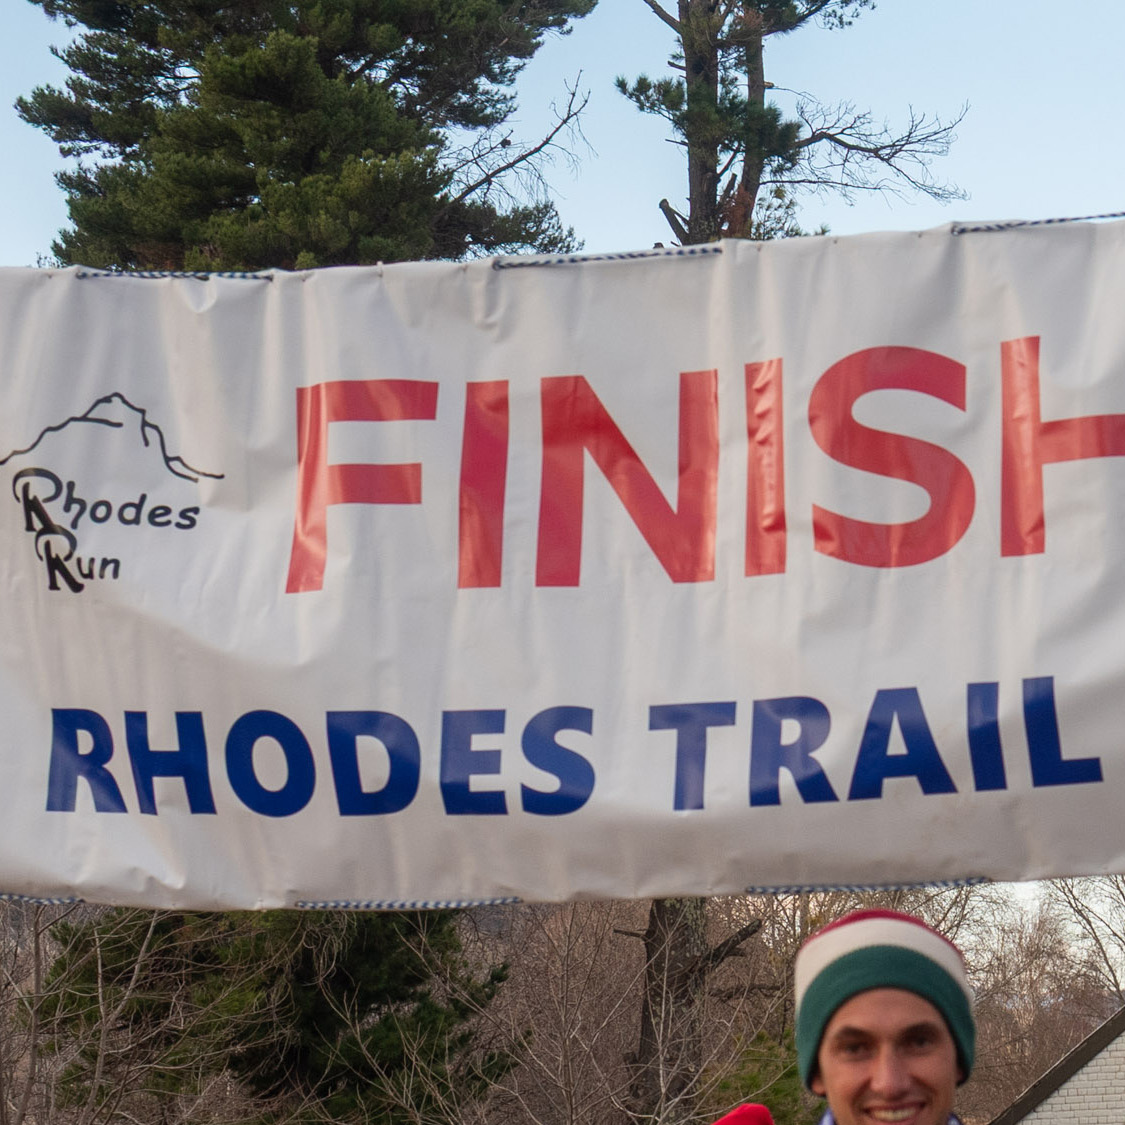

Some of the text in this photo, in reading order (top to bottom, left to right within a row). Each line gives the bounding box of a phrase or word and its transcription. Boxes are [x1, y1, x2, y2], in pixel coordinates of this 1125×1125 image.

[12, 467, 200, 532] Rhodes
[35, 524, 121, 593] Run
[46, 704, 597, 818] RHODES
[648, 675, 1104, 812] TRAIL
